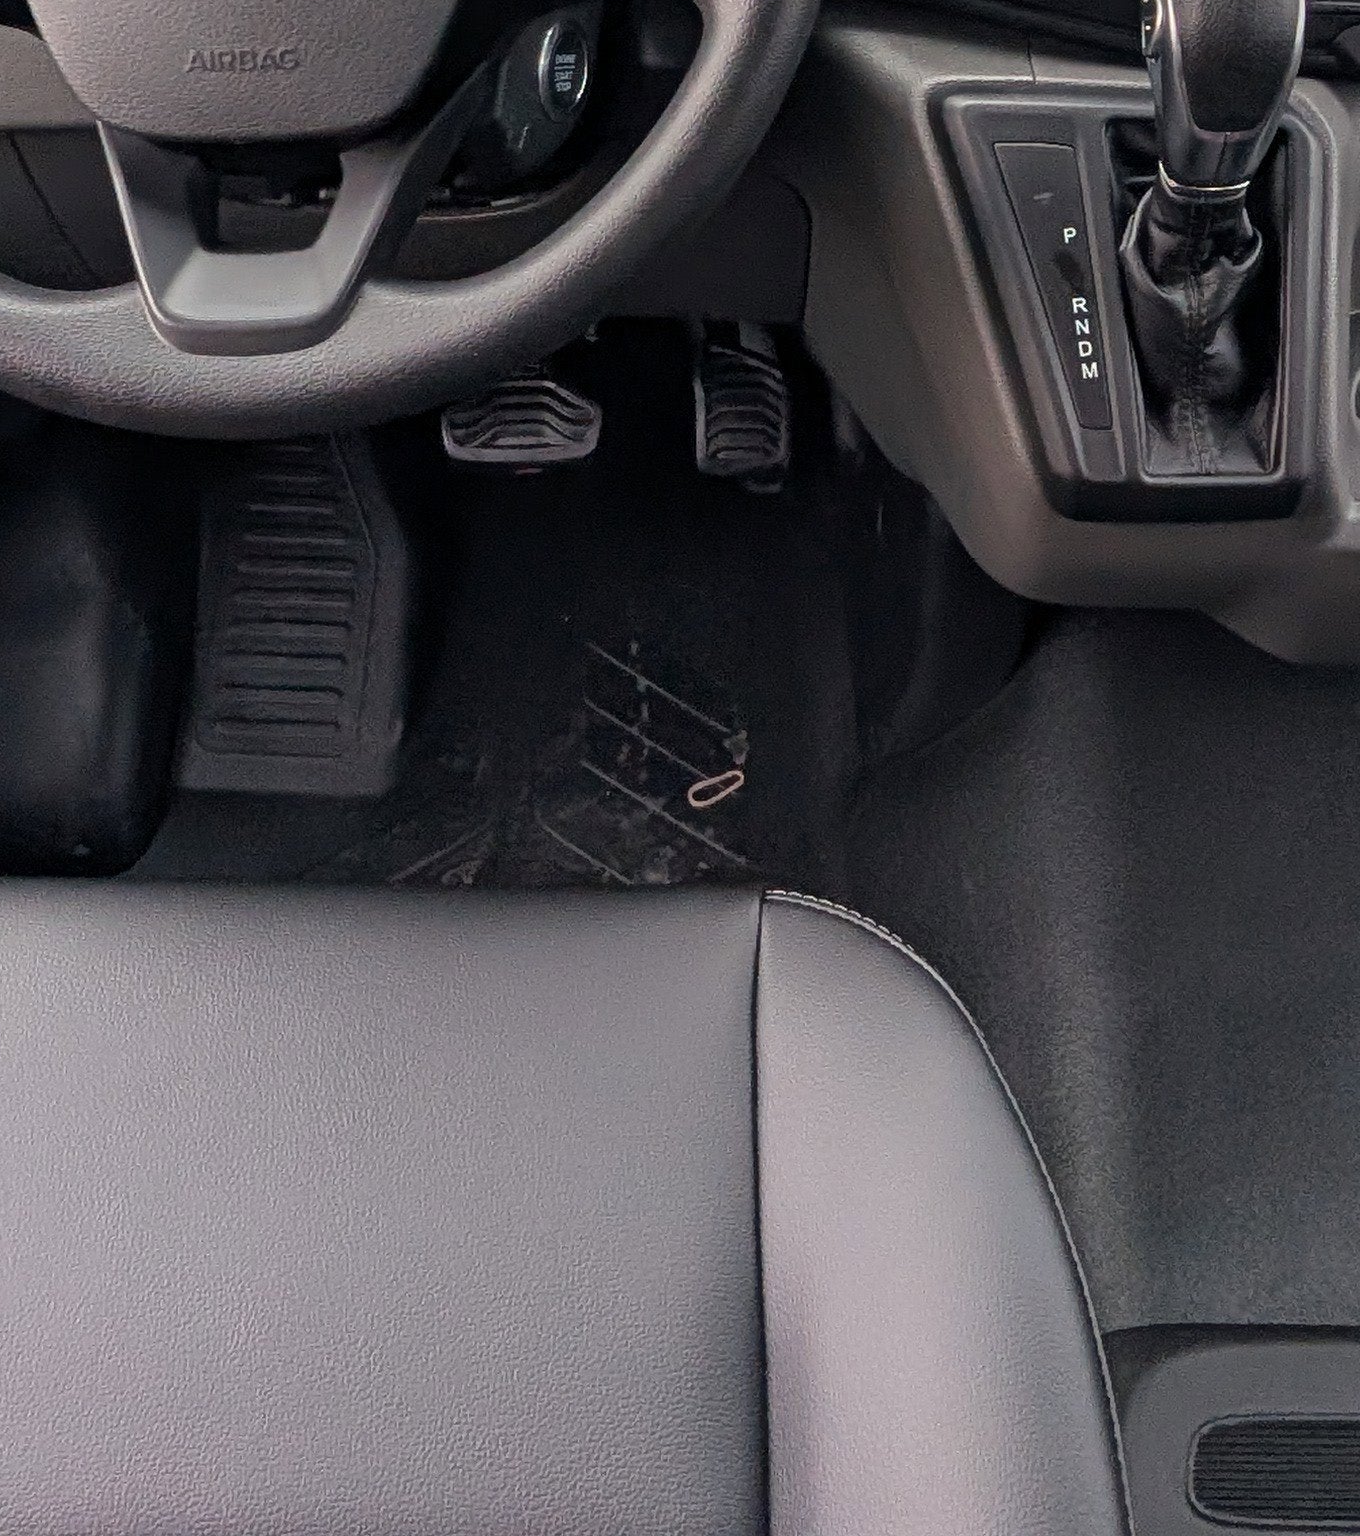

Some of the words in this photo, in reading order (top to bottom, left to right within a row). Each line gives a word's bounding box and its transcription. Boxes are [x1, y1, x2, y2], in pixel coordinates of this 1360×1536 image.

[186, 48, 302, 73] AIRBAG
[1063, 227, 1077, 244] P
[1072, 297, 1089, 314] R
[1075, 319, 1090, 335] N
[1078, 340, 1093, 357] D
[1081, 362, 1099, 379] M
